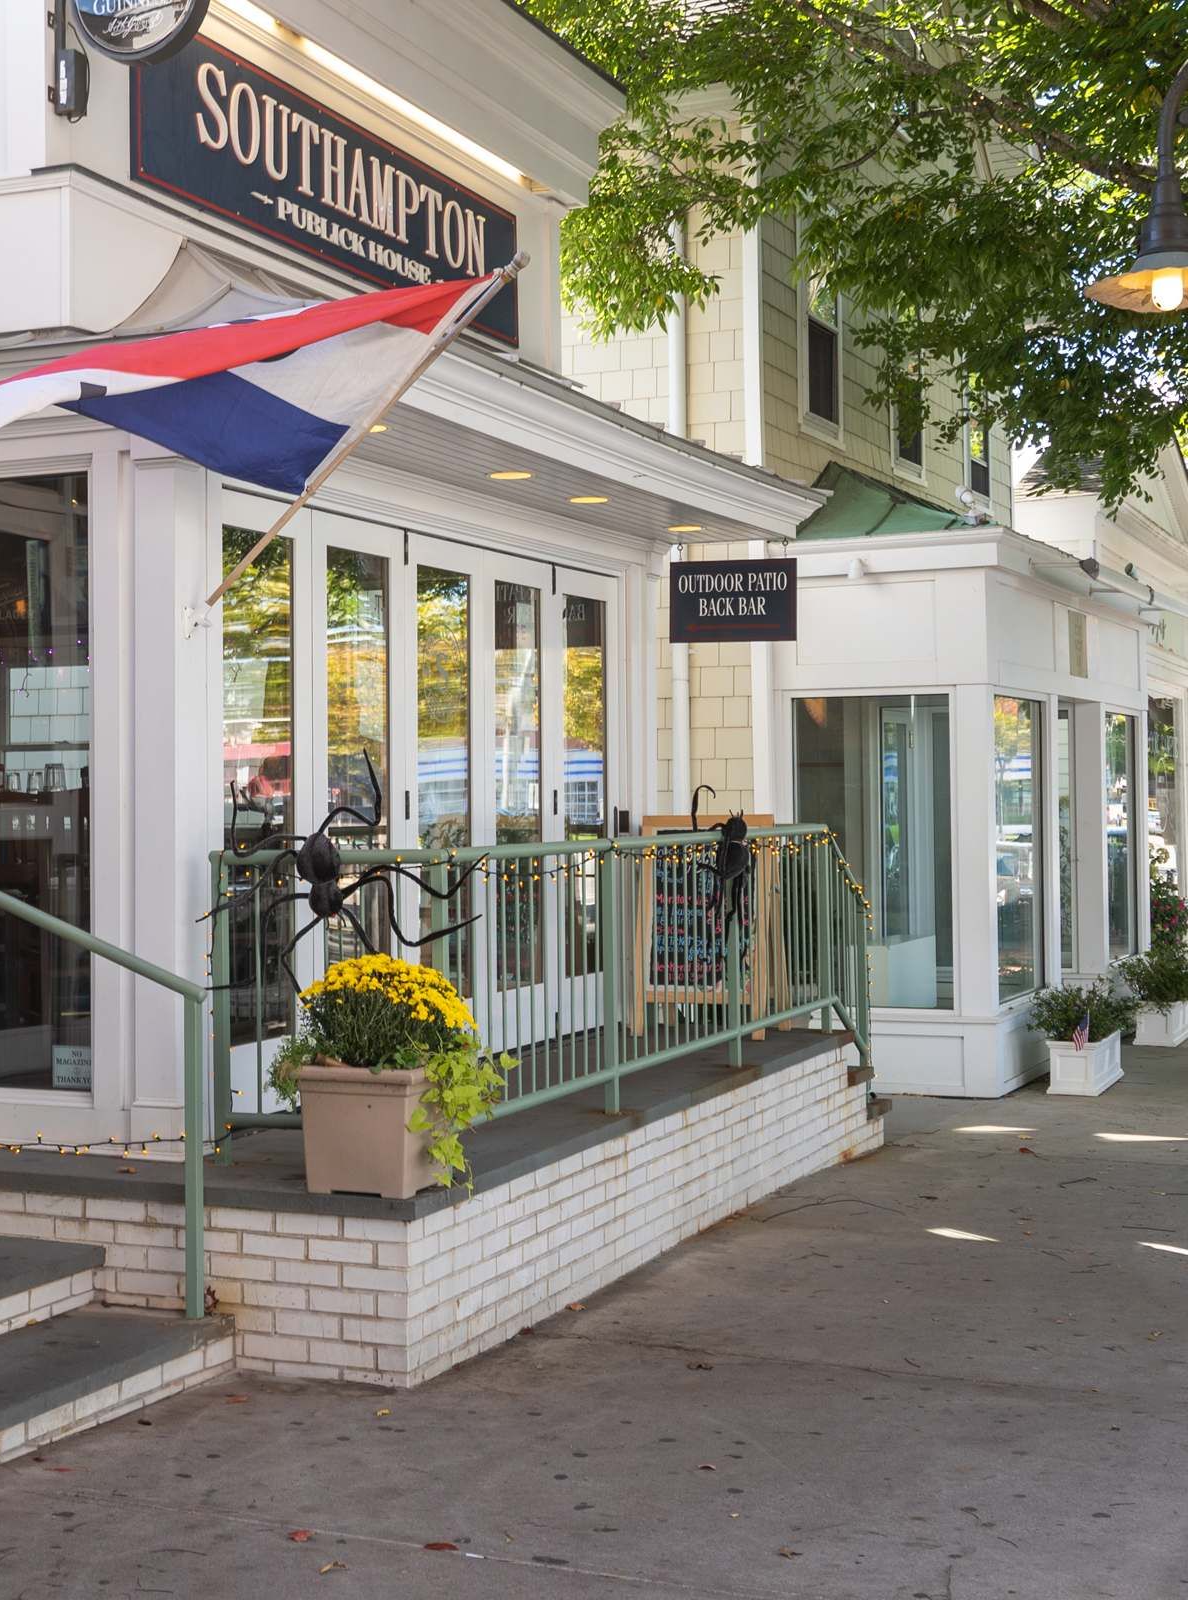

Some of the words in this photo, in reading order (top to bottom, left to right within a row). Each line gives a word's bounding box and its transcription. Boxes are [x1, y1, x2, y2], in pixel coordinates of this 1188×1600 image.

[196, 62, 486, 278] SOUTHAMPTON
[277, 196, 367, 260] PUBLICK
[369, 240, 432, 286] HOUSE
[678, 573, 744, 593] OUTDOOR
[748, 571, 788, 592] PATIO
[699, 597, 735, 617] BACK
[738, 596, 767, 616] BAR
